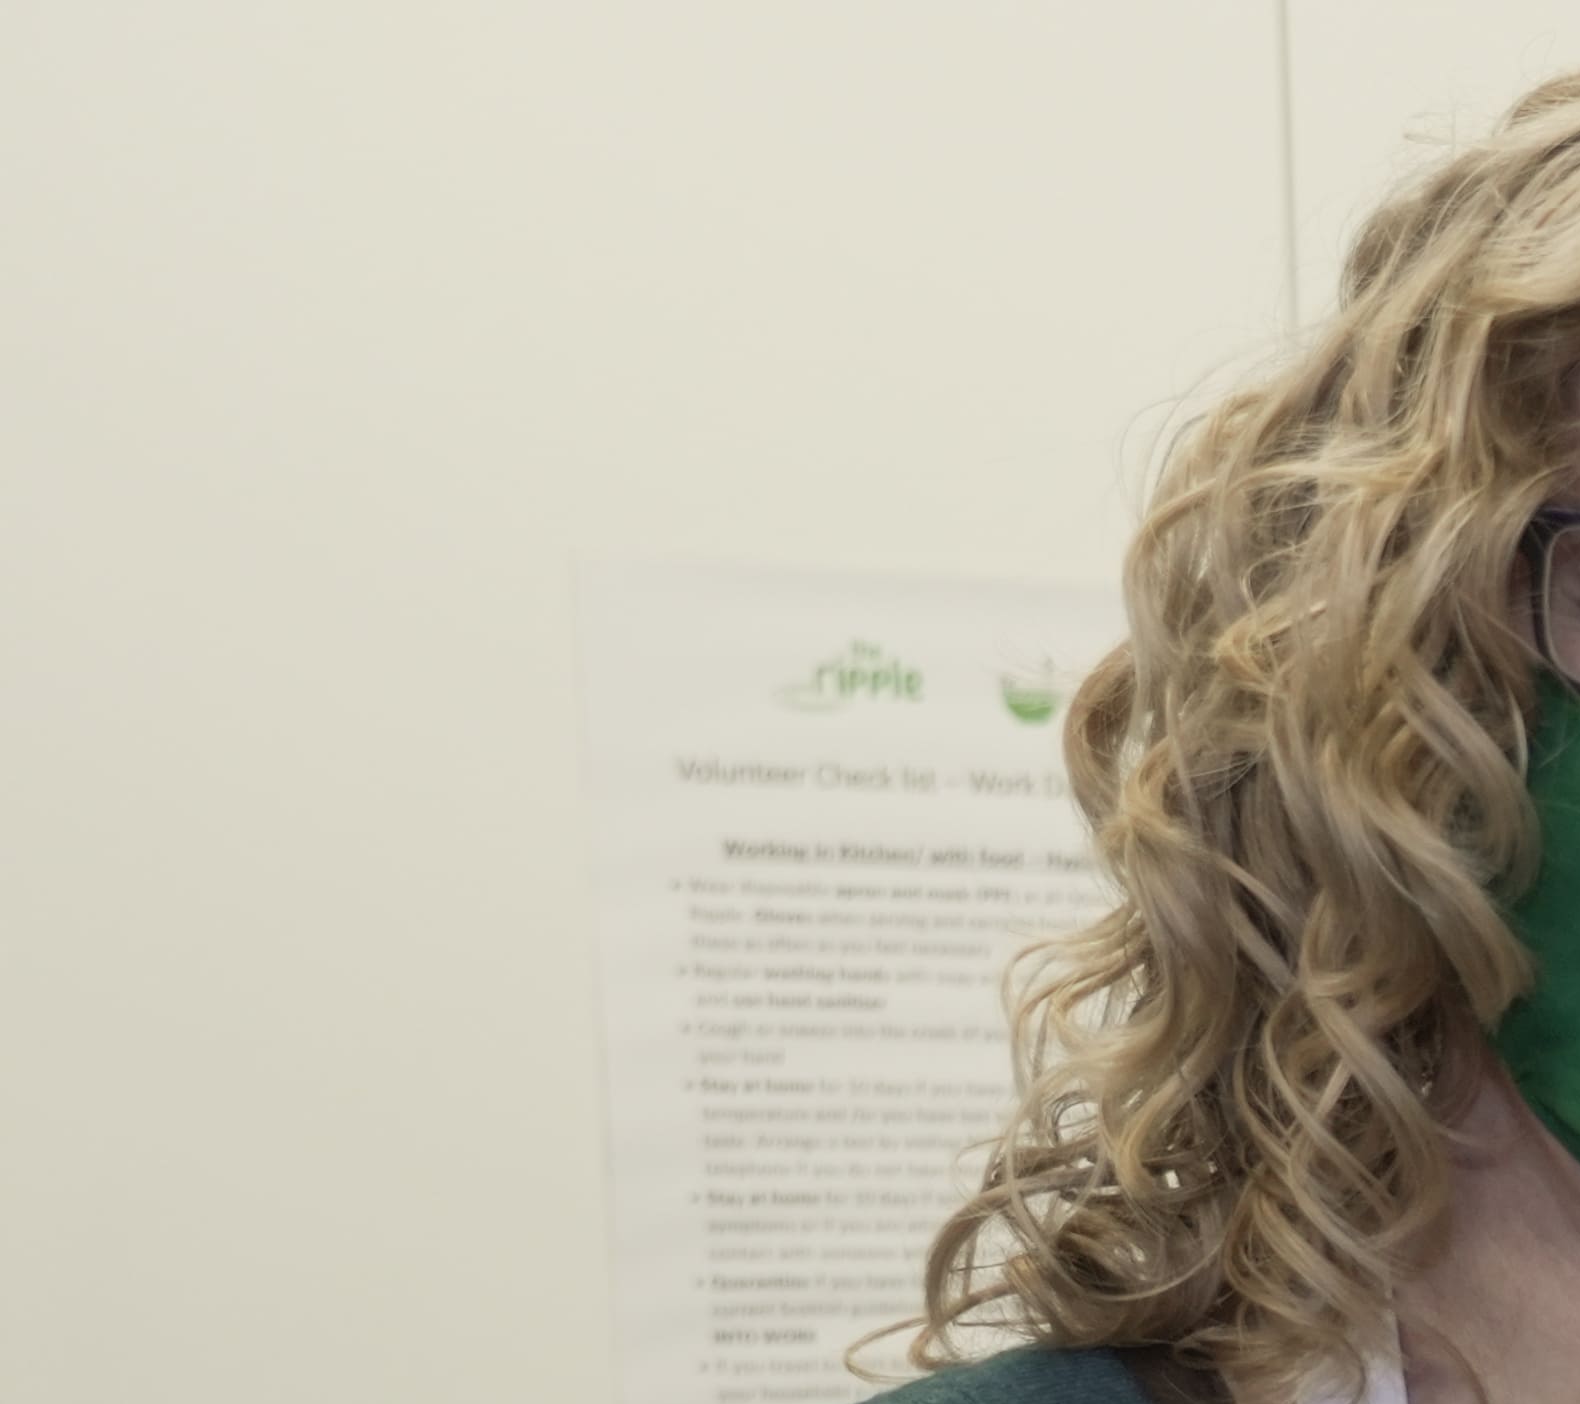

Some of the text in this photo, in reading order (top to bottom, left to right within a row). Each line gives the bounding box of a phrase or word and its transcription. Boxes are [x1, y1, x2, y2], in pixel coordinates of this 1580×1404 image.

[814, 656, 925, 702] ripple
[675, 755, 805, 787] Volunteer
[815, 760, 891, 788] Check
[969, 771, 1034, 795] Work
